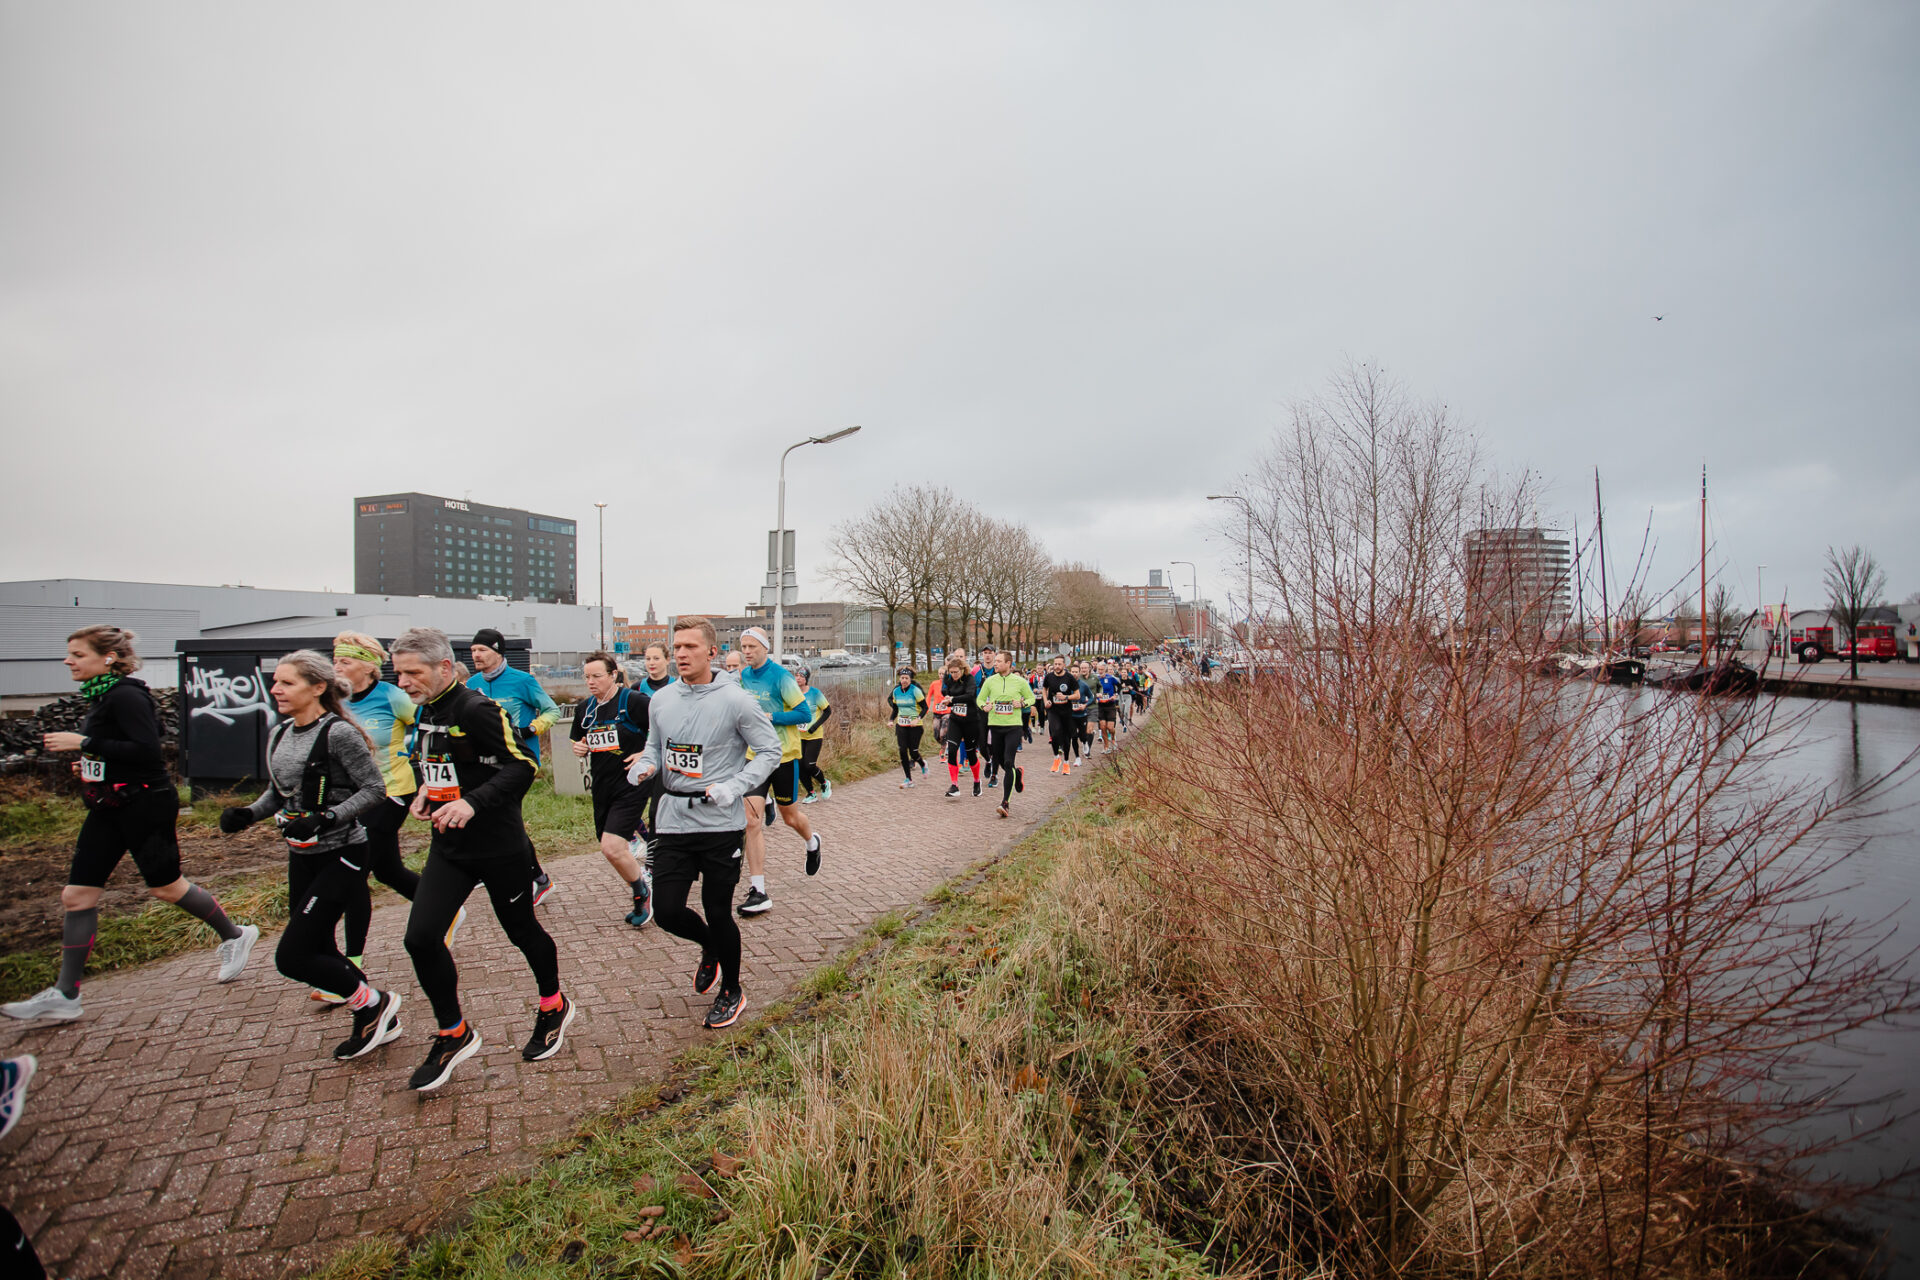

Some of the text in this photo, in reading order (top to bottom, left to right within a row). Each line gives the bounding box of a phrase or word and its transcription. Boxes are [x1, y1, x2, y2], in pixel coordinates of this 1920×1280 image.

[444, 500, 470, 512] HOTEL
[995, 704, 1012, 712] 2210
[588, 732, 615, 745] 2316
